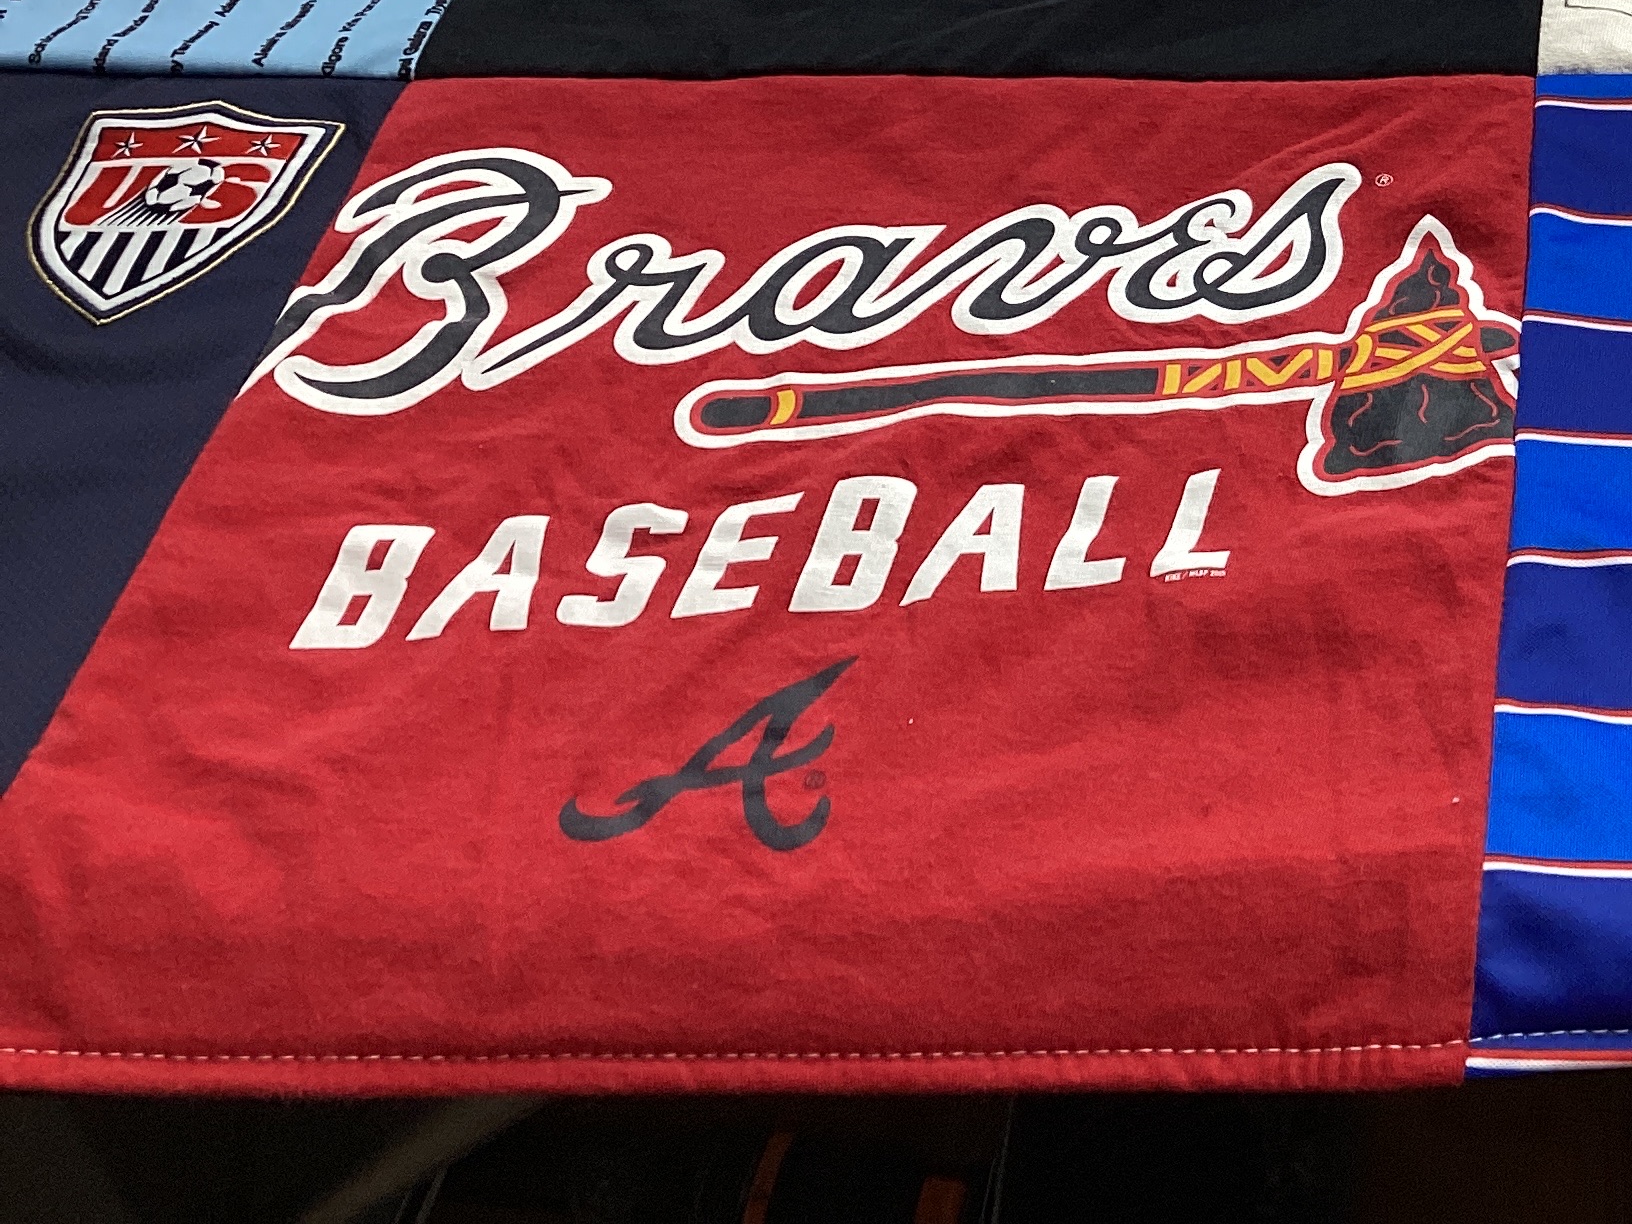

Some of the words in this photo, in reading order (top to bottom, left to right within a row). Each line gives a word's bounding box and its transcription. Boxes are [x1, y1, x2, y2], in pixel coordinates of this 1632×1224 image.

[240, 148, 1363, 414] Braves
[289, 467, 1231, 651] BASEBALL
[557, 655, 858, 851] A
